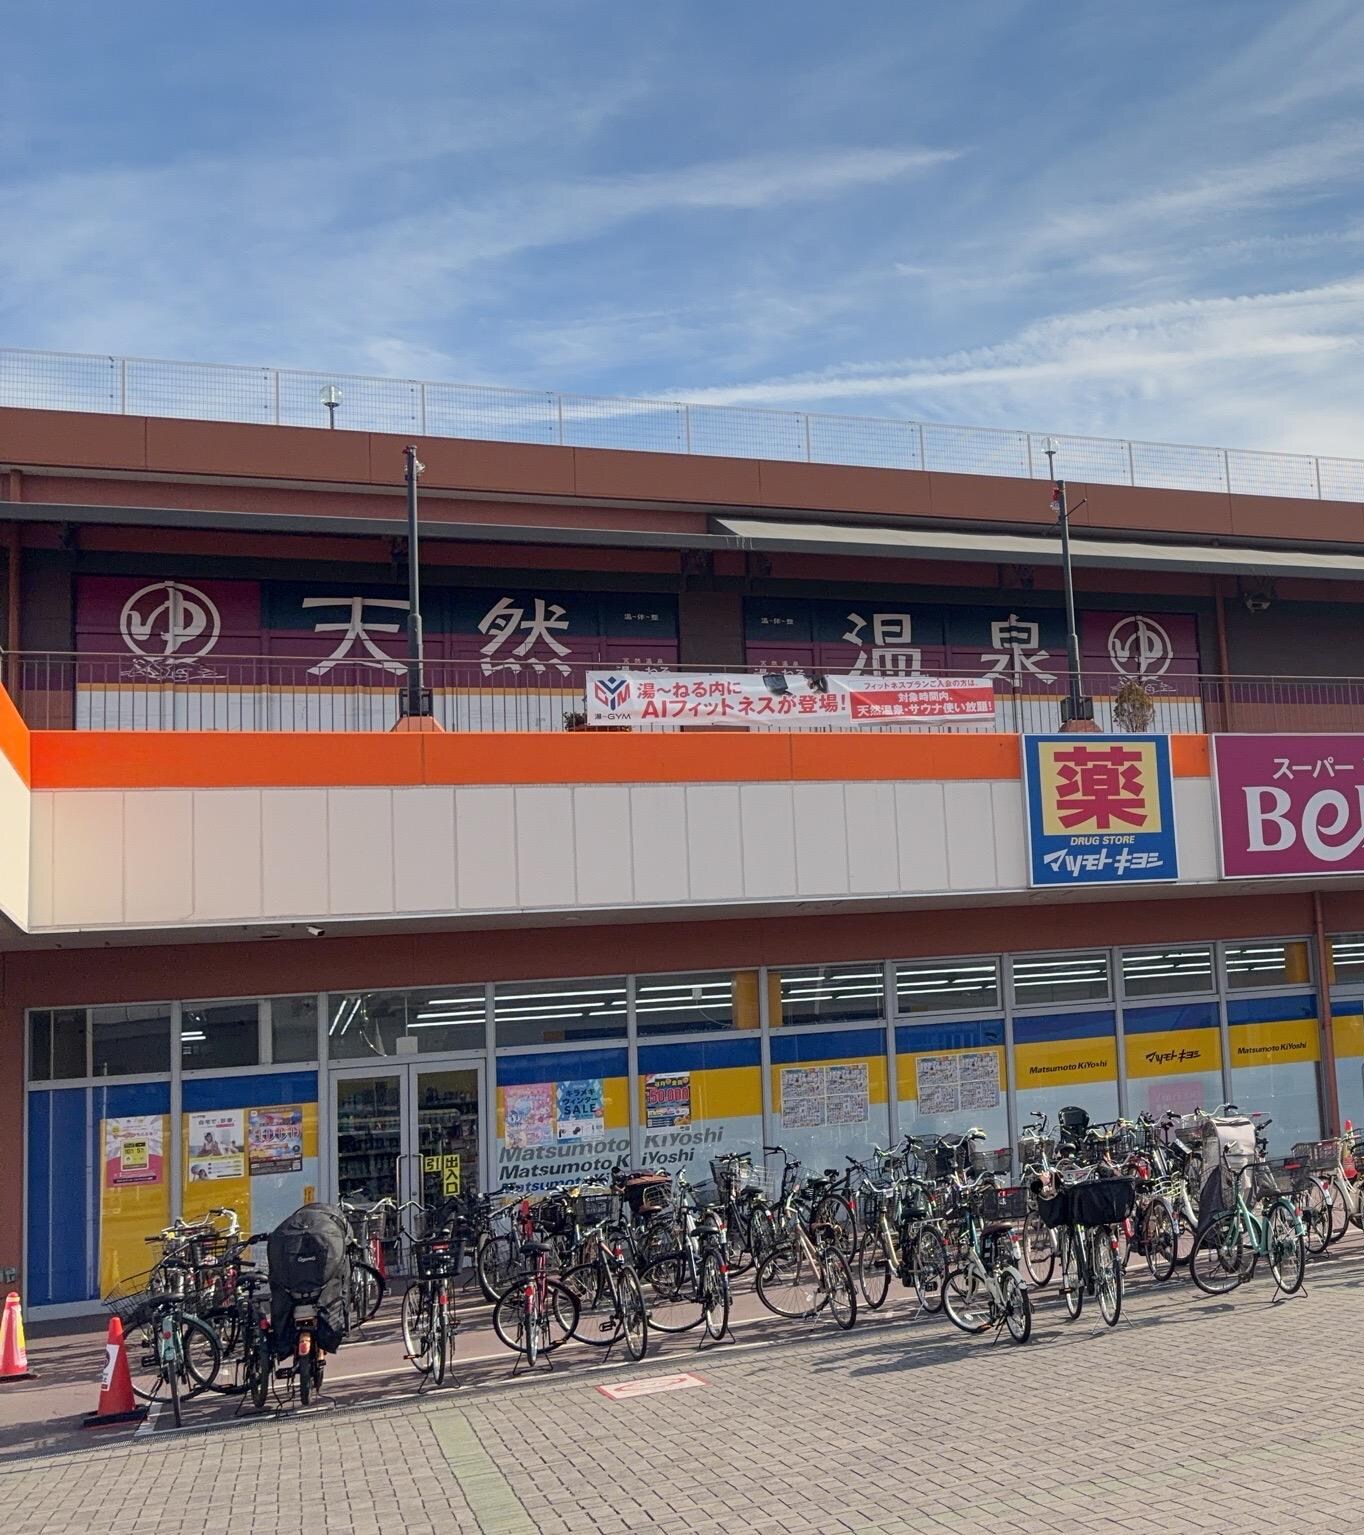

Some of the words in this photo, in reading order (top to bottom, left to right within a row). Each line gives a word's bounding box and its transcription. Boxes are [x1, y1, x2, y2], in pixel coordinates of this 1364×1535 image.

[1272, 757, 1354, 780] スーパー
[1053, 745, 1148, 829] 薬
[1070, 837, 1100, 846] DRUG
[1102, 835, 1136, 845] STORE
[1043, 848, 1164, 877] マツモトキヨシ
[1238, 1046, 1280, 1055] Matsumoto
[1029, 1063, 1077, 1074] Matsumoto
[564, 1104, 597, 1115] SALE
[500, 1138, 631, 1164] Matsumoto
[445, 1156, 459, 1193] 出入口
[500, 1156, 613, 1181] Matsumoto
